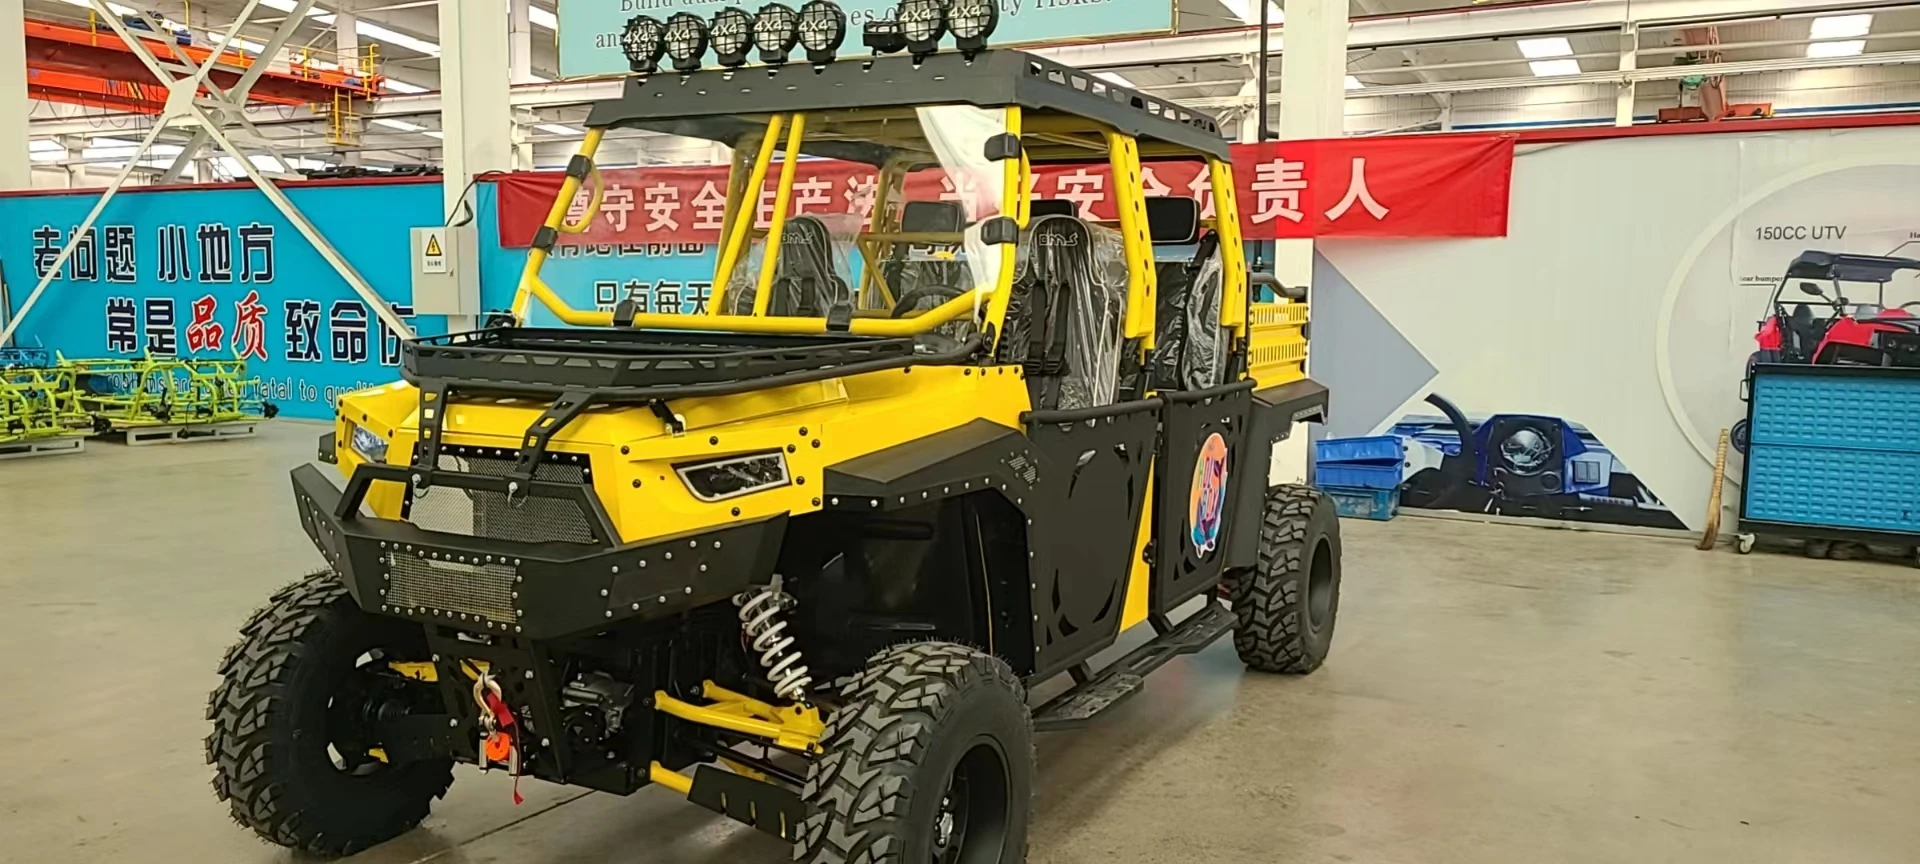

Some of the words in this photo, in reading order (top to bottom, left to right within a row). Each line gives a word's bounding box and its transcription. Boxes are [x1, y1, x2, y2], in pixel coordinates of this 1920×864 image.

[33, 225, 136, 282] 老问题
[158, 223, 274, 283] 小地方
[1755, 226, 1807, 240] 150CC
[1811, 226, 1847, 240] UTV
[106, 290, 268, 362] 常是品质
[299, 378, 318, 402] to
